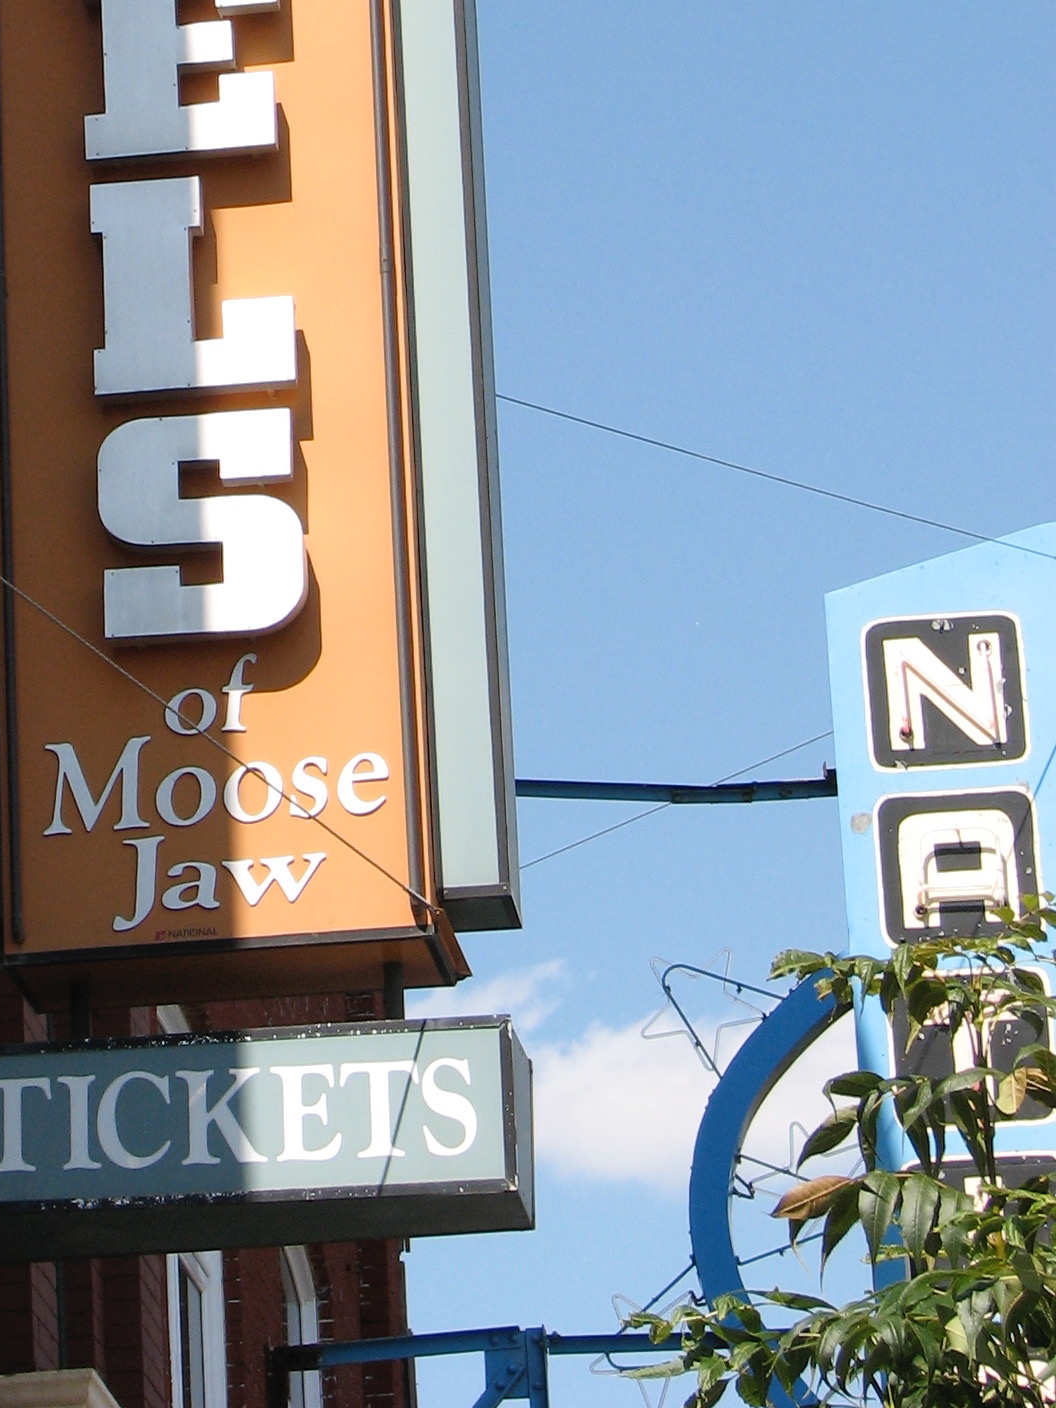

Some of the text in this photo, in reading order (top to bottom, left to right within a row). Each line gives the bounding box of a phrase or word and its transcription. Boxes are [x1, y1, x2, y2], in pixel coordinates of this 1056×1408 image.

[163, 652, 258, 736] of
[43, 735, 390, 837] Moose
[111, 835, 327, 932] Jaw
